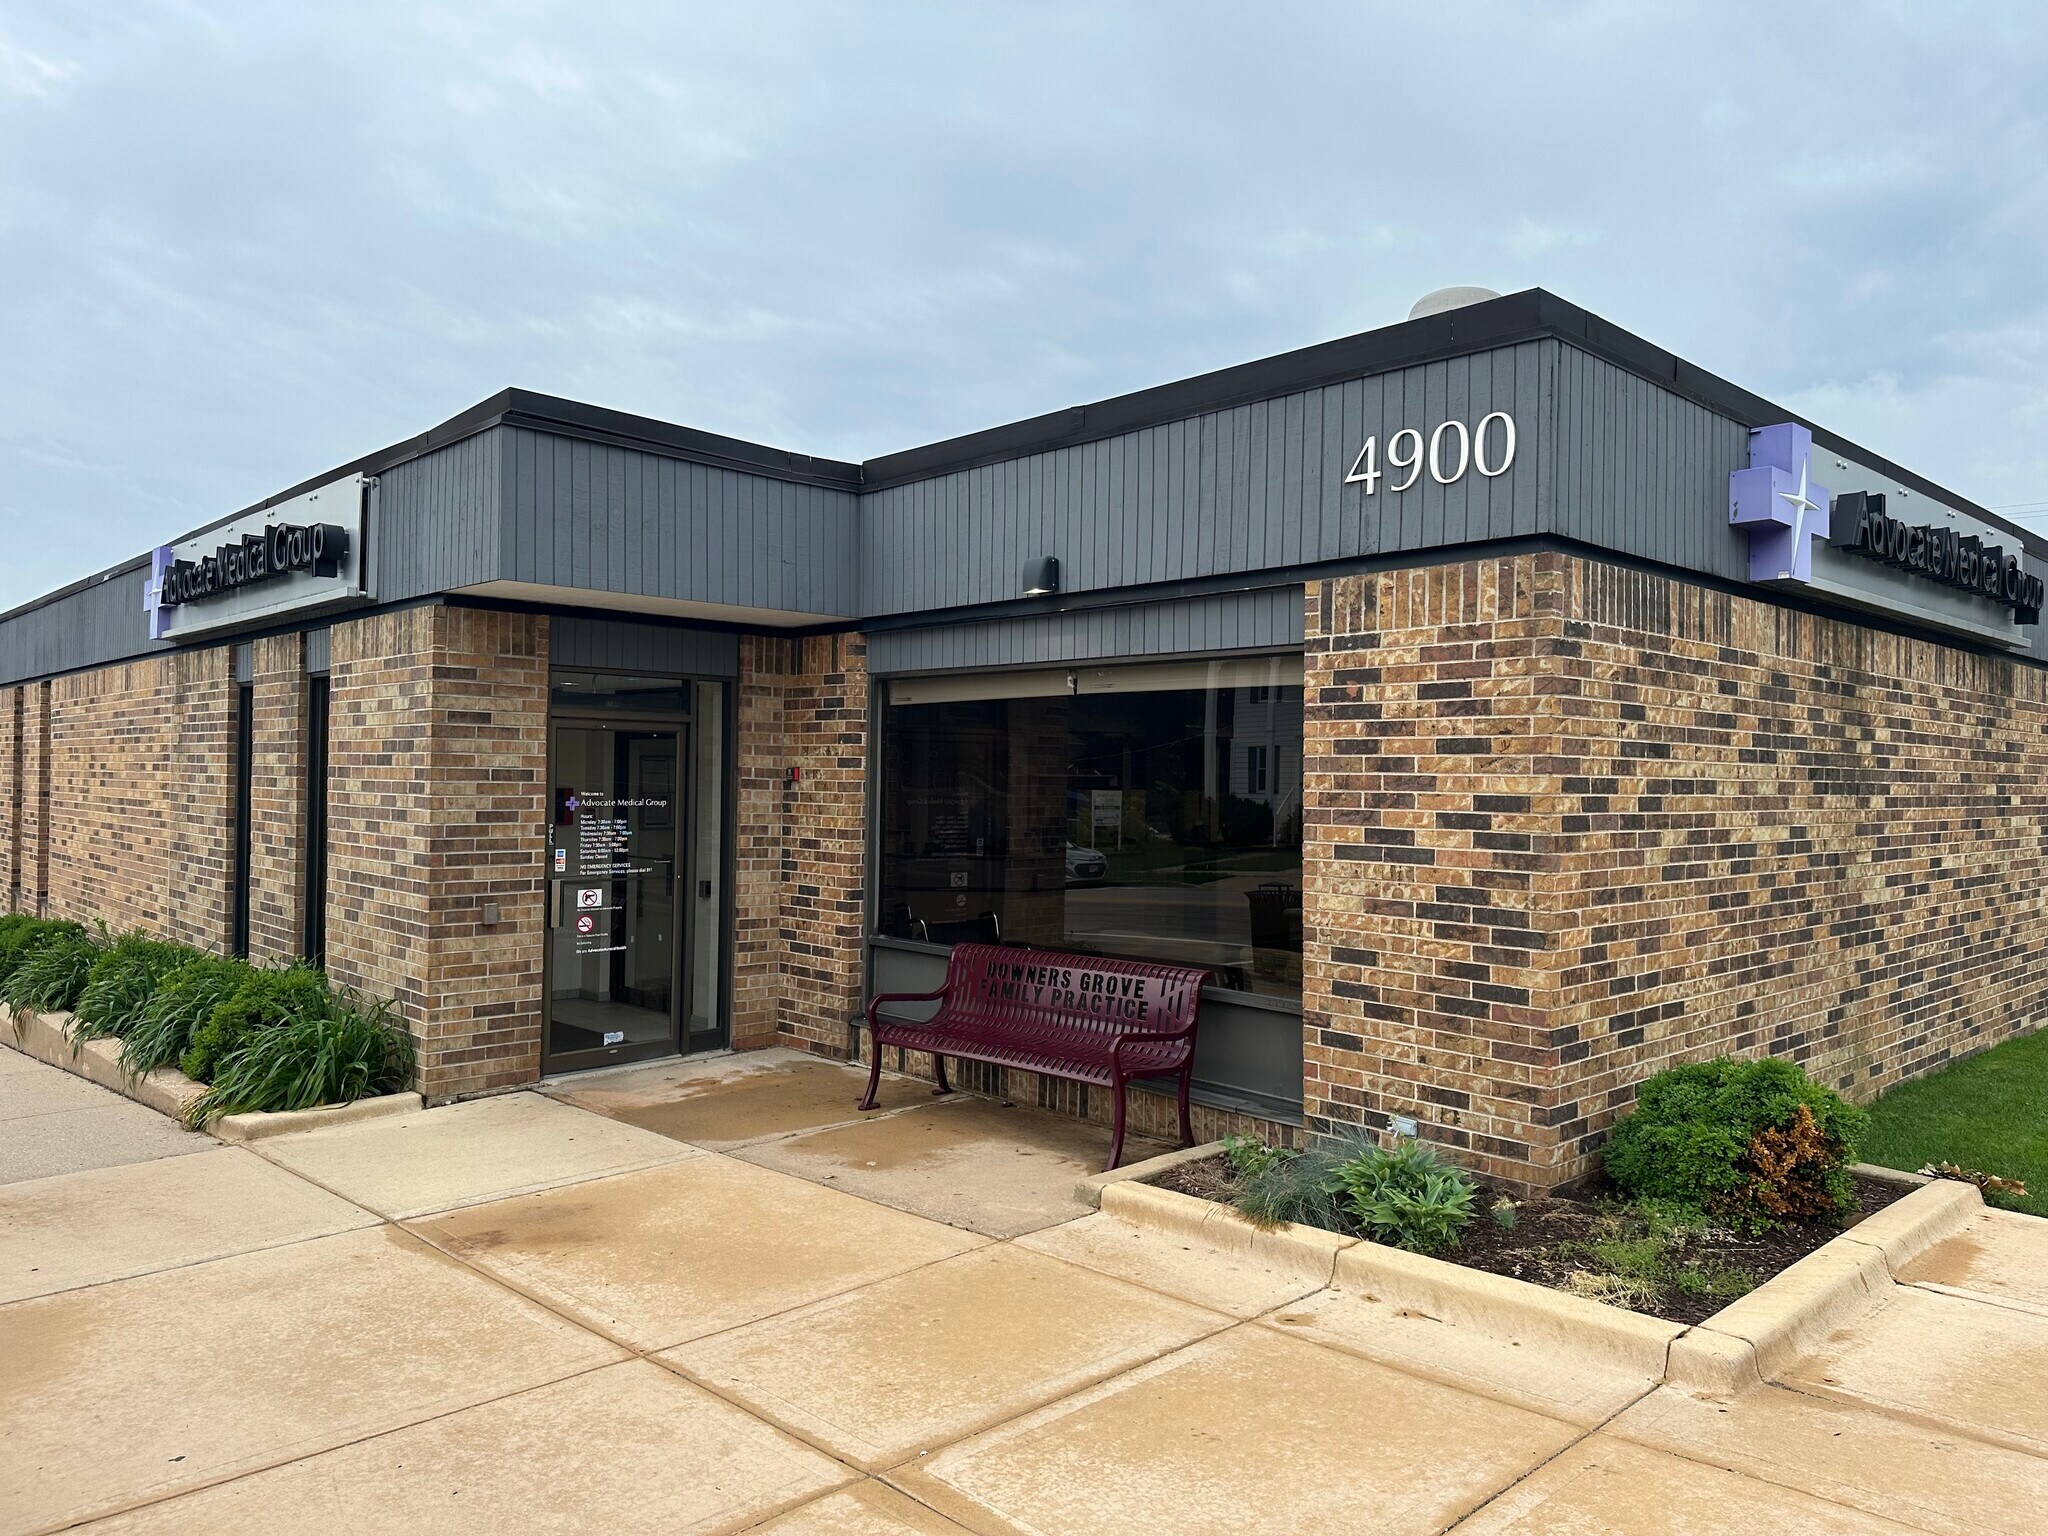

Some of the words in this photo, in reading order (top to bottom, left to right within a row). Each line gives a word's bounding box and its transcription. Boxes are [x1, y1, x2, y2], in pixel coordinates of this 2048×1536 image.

[1344, 411, 1516, 495] 4900
[161, 555, 217, 604] Advocate
[216, 524, 269, 588] Medical
[272, 522, 332, 577] Group
[1846, 491, 1943, 575] Advocate
[1943, 526, 2003, 598] Medical
[580, 799, 616, 807] Advocate
[617, 798, 645, 807] Medical
[645, 798, 667, 808] Group
[978, 978, 1045, 1005] FAMILY
[1050, 988, 1149, 1021] PRACTICE
[986, 960, 1072, 989] DOWNERS
[1079, 972, 1146, 999] GROVE
